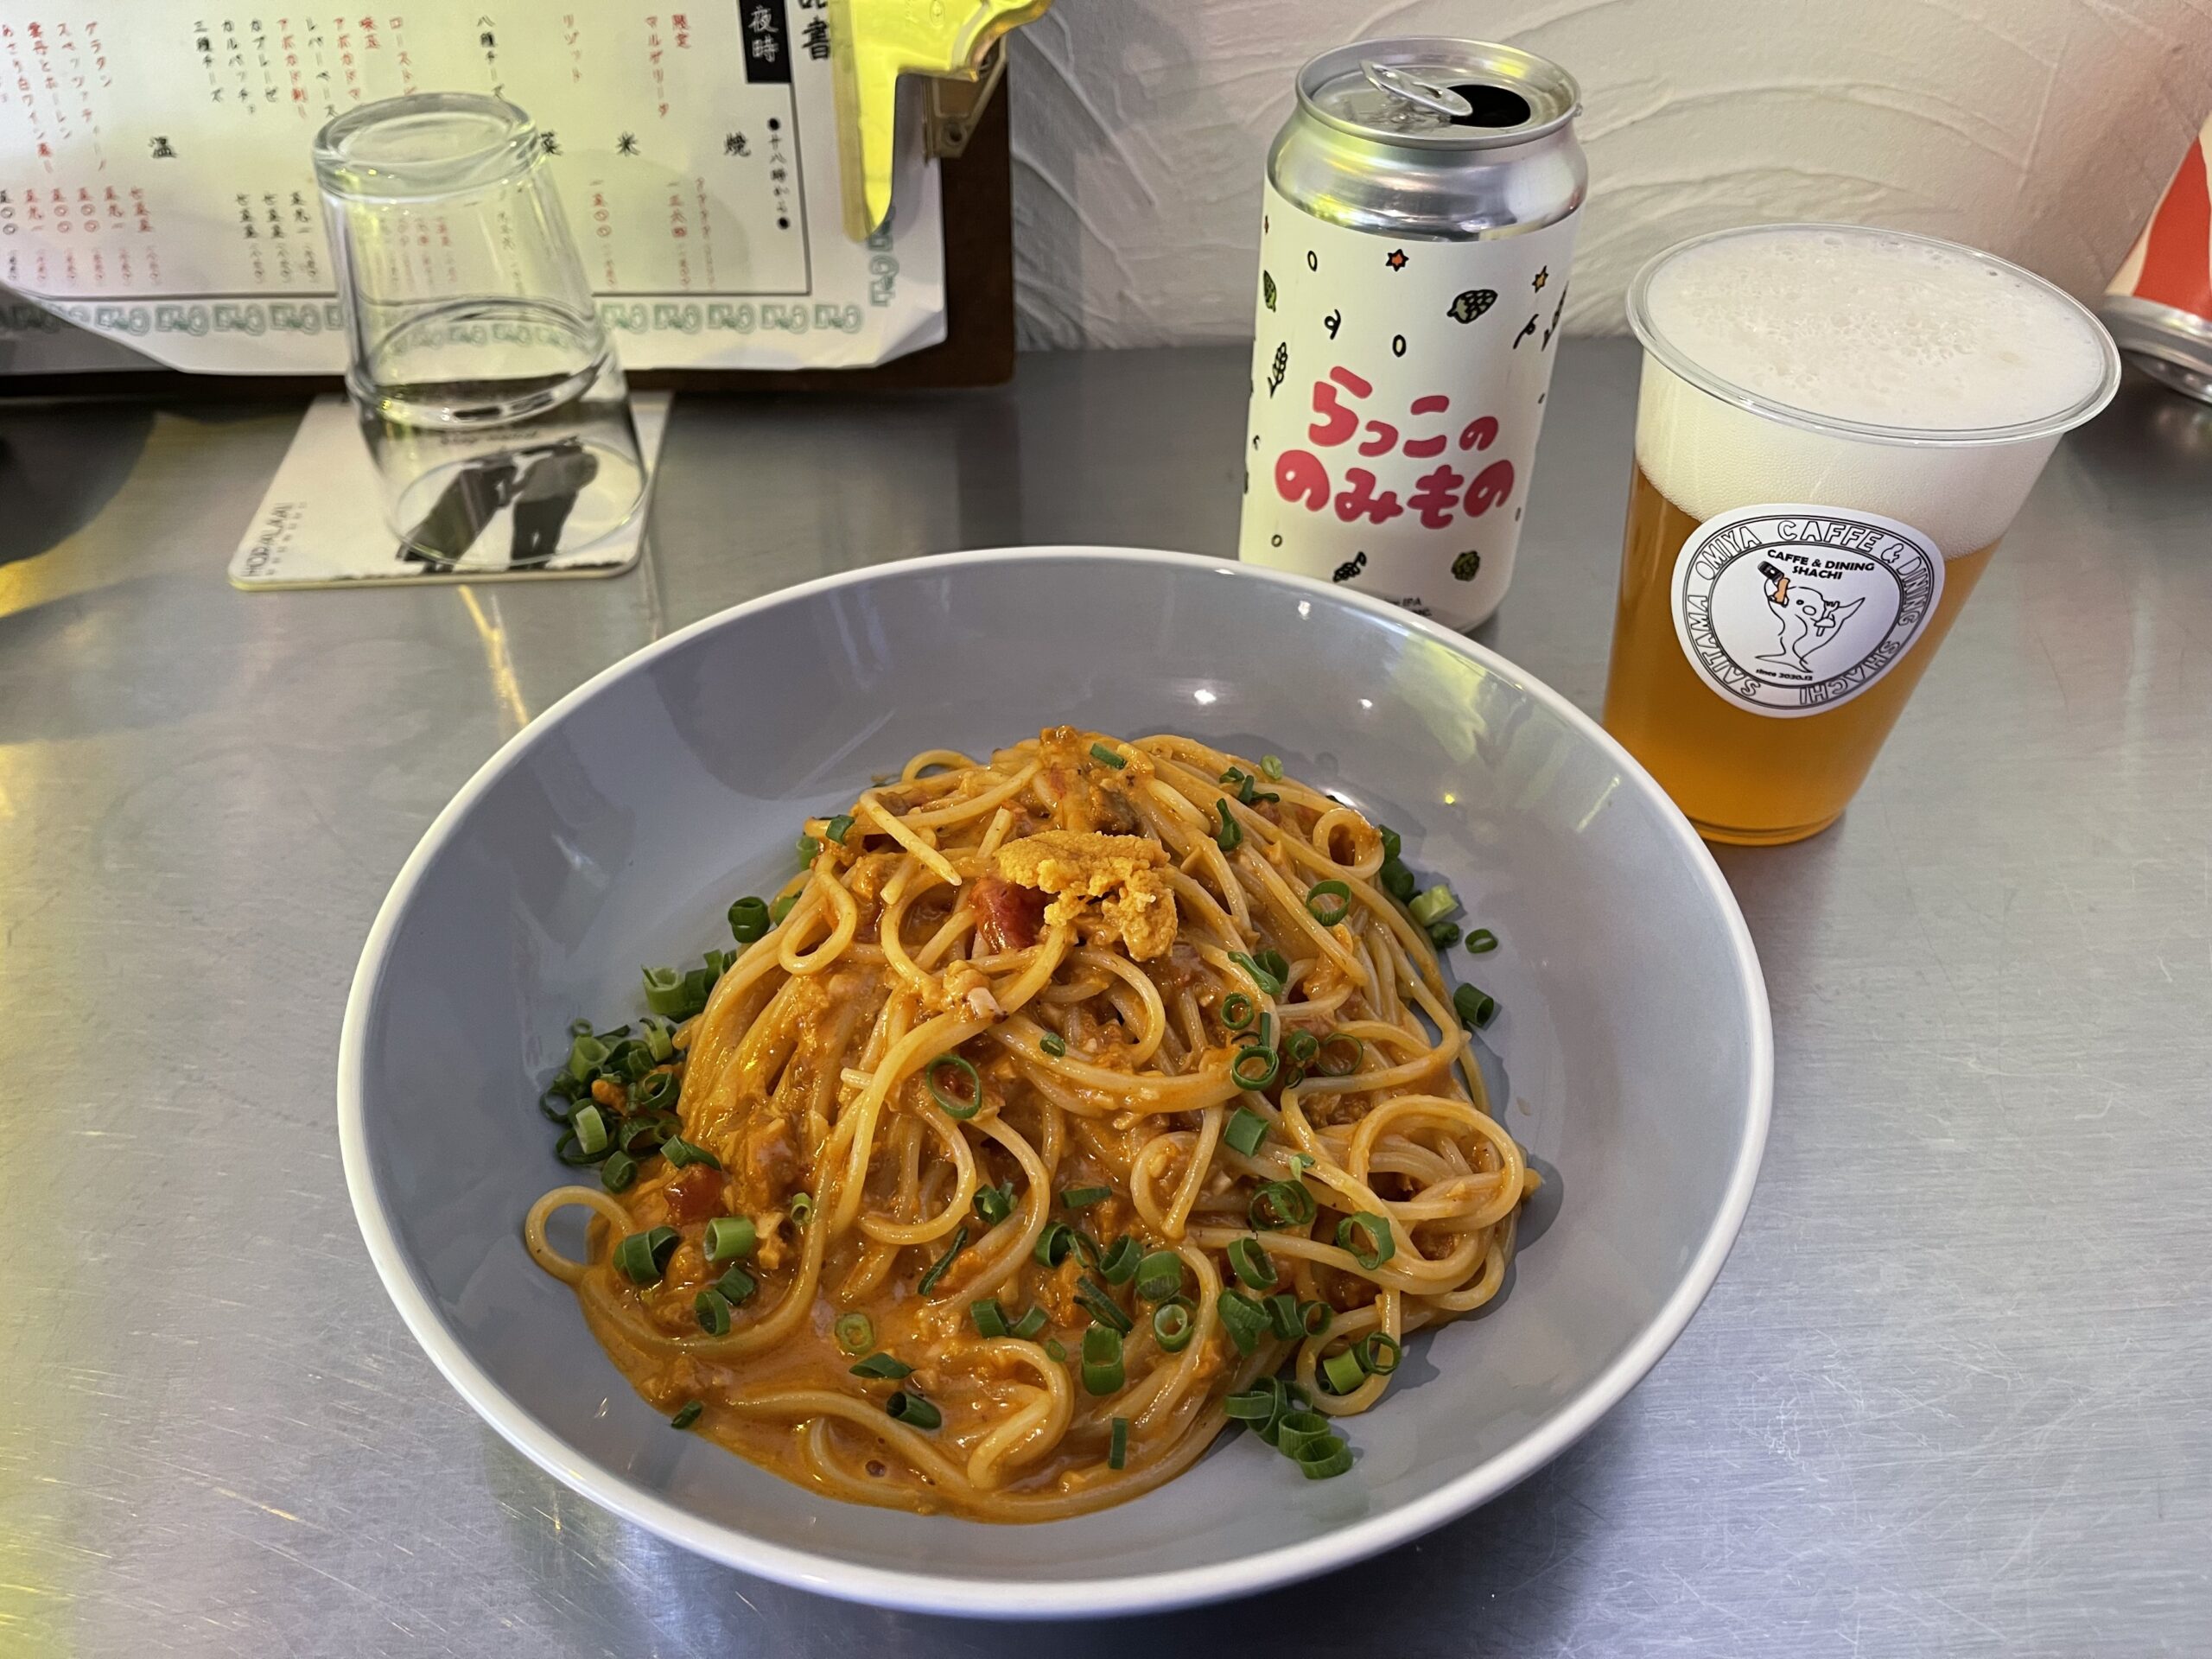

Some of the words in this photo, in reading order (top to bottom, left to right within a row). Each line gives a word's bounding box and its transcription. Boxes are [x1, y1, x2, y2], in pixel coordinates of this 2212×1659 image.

[798, 0, 830, 60] 書
[618, 131, 640, 156] 米
[1308, 365, 1499, 458] らっこの
[1274, 449, 1516, 530] のみもの
[1695, 526, 1762, 581] OMIYA
[1767, 550, 1808, 567] CAFFE
[1812, 559, 1821, 568] &
[1824, 560, 1875, 572] DINING
[1777, 520, 1884, 553] CAFFE
[1880, 543, 1904, 563] &
[1792, 565, 1842, 580] SHACHI
[1897, 556, 1929, 626] DINING
[1688, 594, 1761, 697] SAITAMA
[1799, 641, 1900, 705] SHACHI
